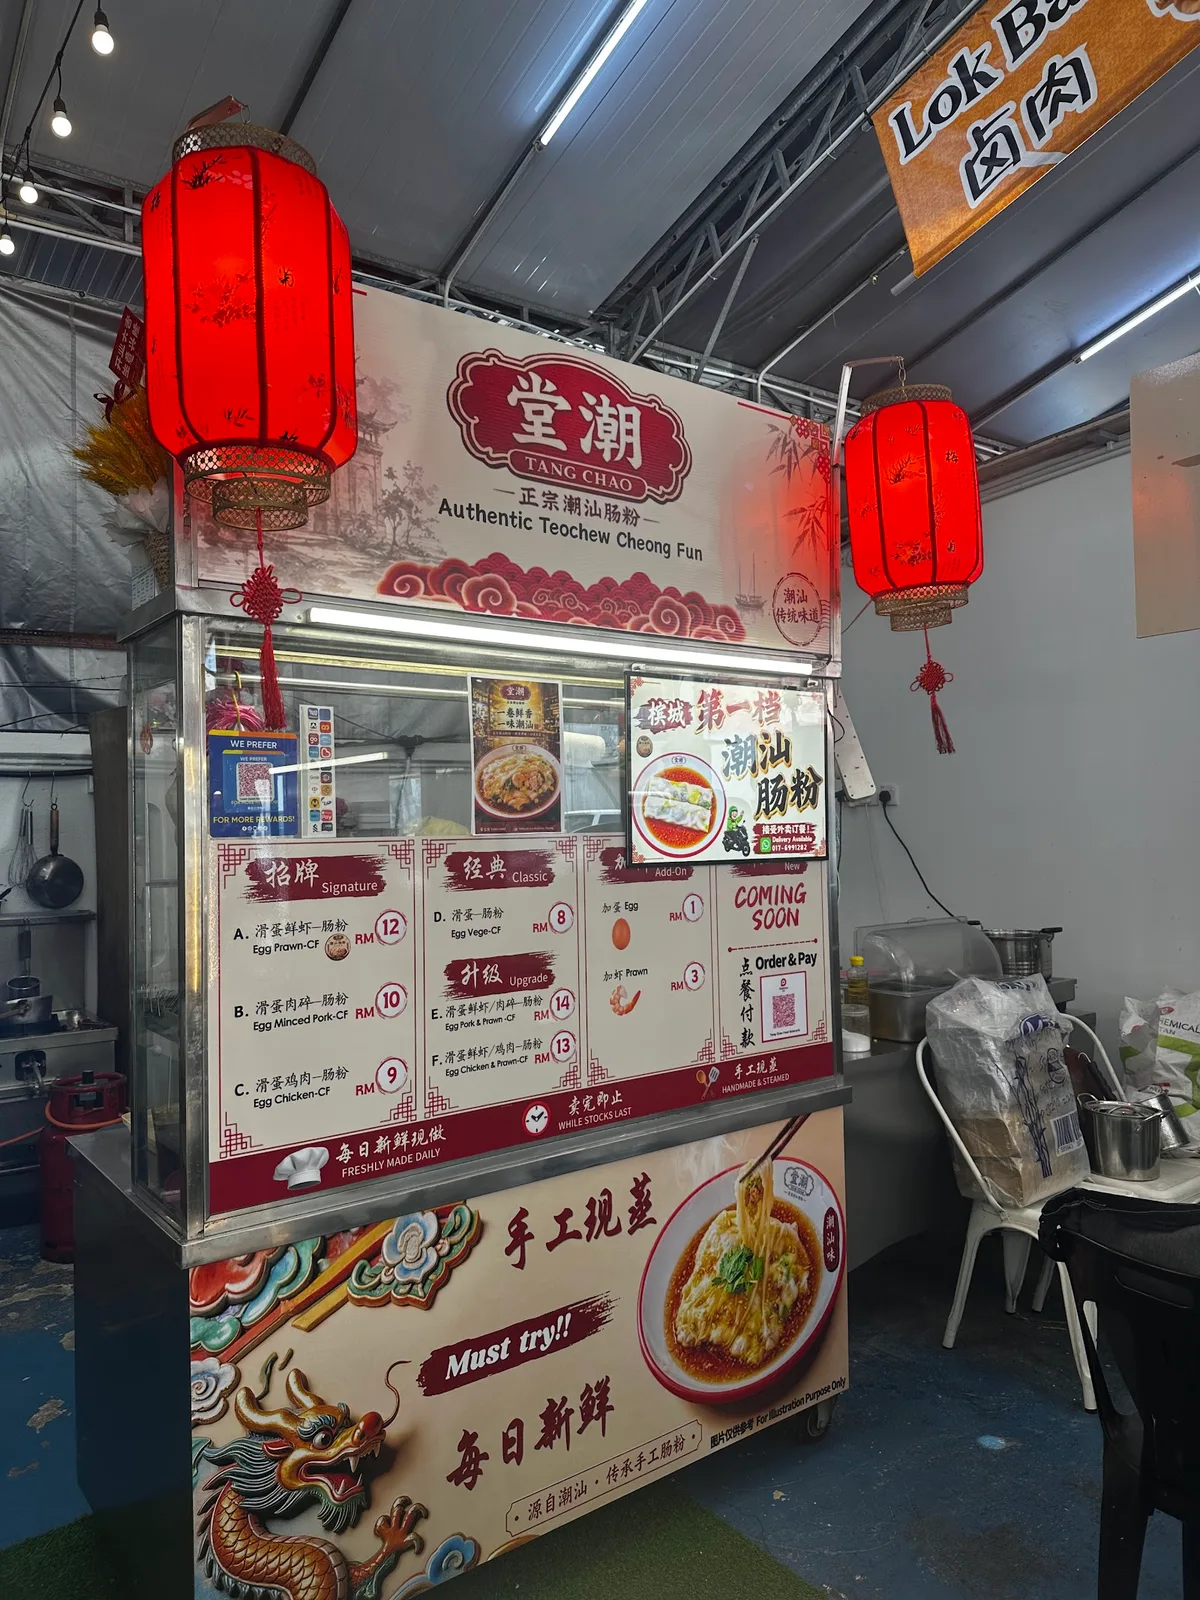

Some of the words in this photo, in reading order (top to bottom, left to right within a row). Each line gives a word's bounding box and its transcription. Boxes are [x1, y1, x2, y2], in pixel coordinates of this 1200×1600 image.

[893, 48, 998, 158] Lok
[964, 57, 1092, 201] 卤肉
[506, 371, 642, 470] 堂潮
[524, 456, 577, 480] TANG
[582, 470, 633, 492] CHAO
[519, 486, 641, 527] 正宗潮汕肠粉
[438, 498, 533, 530] Authentic
[539, 516, 610, 545] Teochew
[617, 532, 671, 559] Cheong
[677, 542, 703, 561] Fun
[783, 587, 808, 605] 潮汕
[776, 607, 821, 624] 传统味道
[648, 700, 686, 726] 槟城
[695, 687, 781, 735] 第一档
[230, 740, 245, 748] WE
[246, 740, 277, 749] PREFER
[721, 730, 792, 781] 潮汕
[754, 765, 824, 821] 肠粉
[213, 816, 229, 824] FOR
[256, 815, 295, 823] REWARDS!
[264, 859, 320, 888] 招牌
[463, 853, 507, 881] 经典
[512, 871, 548, 883] Classic
[655, 866, 687, 877] Add-On
[784, 862, 800, 871] New
[321, 882, 378, 896] Signature
[734, 882, 807, 908] COMING
[434, 911, 446, 923] D.
[624, 901, 639, 911] Egg
[669, 912, 682, 922] RM
[690, 900, 696, 914] 1
[752, 906, 800, 930] SOON
[355, 933, 374, 944] RM
[382, 918, 399, 936] 12
[451, 929, 466, 939] Egg
[467, 926, 502, 937] Vege-CF
[532, 923, 548, 933] RM
[557, 909, 566, 925] 8
[233, 928, 249, 940] A.
[253, 945, 272, 956] Egg
[274, 940, 320, 952] Prawn-CF
[625, 967, 648, 977] Prawn
[755, 954, 787, 970] Order
[788, 954, 797, 965] &
[798, 952, 817, 967] Pay
[460, 961, 503, 989] 升级
[509, 973, 548, 988] Upgrade
[670, 981, 684, 991] RM
[691, 969, 699, 983] 3
[234, 1005, 249, 1018] B.
[355, 1007, 374, 1019] RM
[382, 991, 401, 1009] 10
[431, 1008, 443, 1020] E.
[534, 1009, 549, 1021] RM
[555, 995, 570, 1011] 14
[739, 957, 755, 1048] 点餐付款
[253, 1021, 272, 1032] Egg
[274, 1016, 311, 1029] Minced
[312, 1010, 349, 1023] Pork-CF
[445, 1022, 459, 1032] Egg
[460, 1018, 475, 1030] Pork
[476, 1019, 482, 1027] &
[482, 1016, 503, 1026] Prawn
[431, 1054, 443, 1067] F.
[534, 1052, 550, 1064] RM
[556, 1037, 570, 1054] 13
[445, 1067, 460, 1077] Egg
[460, 1062, 490, 1074] Chicken
[490, 1061, 496, 1069] &
[496, 1055, 529, 1068] Prawn-CF
[734, 1056, 779, 1077] 手工现蒸
[234, 1083, 249, 1097] C.
[355, 1082, 375, 1096] RM
[387, 1066, 397, 1084] 9
[722, 1079, 756, 1094] HANDMADE
[757, 1079, 762, 1087] &
[763, 1072, 790, 1086] STEAMED
[253, 1098, 272, 1109] Egg
[274, 1086, 331, 1104] Chicken-CF
[568, 1090, 623, 1115] 卖完即止
[558, 1117, 583, 1131] WHILE
[584, 1111, 613, 1127] STOCKS
[614, 1107, 632, 1121] LAST
[335, 1123, 447, 1164] 每日新鲜现做
[342, 1159, 385, 1178] FRESHLY
[386, 1154, 413, 1168] MADE
[415, 1147, 441, 1162] DAILY
[504, 1171, 657, 1270] 手工现蒸
[445, 1336, 511, 1380] Must
[519, 1312, 572, 1353] try!!
[756, 1413, 768, 1427] For
[768, 1397, 805, 1420] Illustration
[805, 1385, 831, 1403] Purpose
[831, 1377, 846, 1391] Only
[446, 1375, 615, 1491] 每日新鲜
[528, 1480, 588, 1522] 源自潮汕
[606, 1434, 686, 1485] 传承手工肠粉
